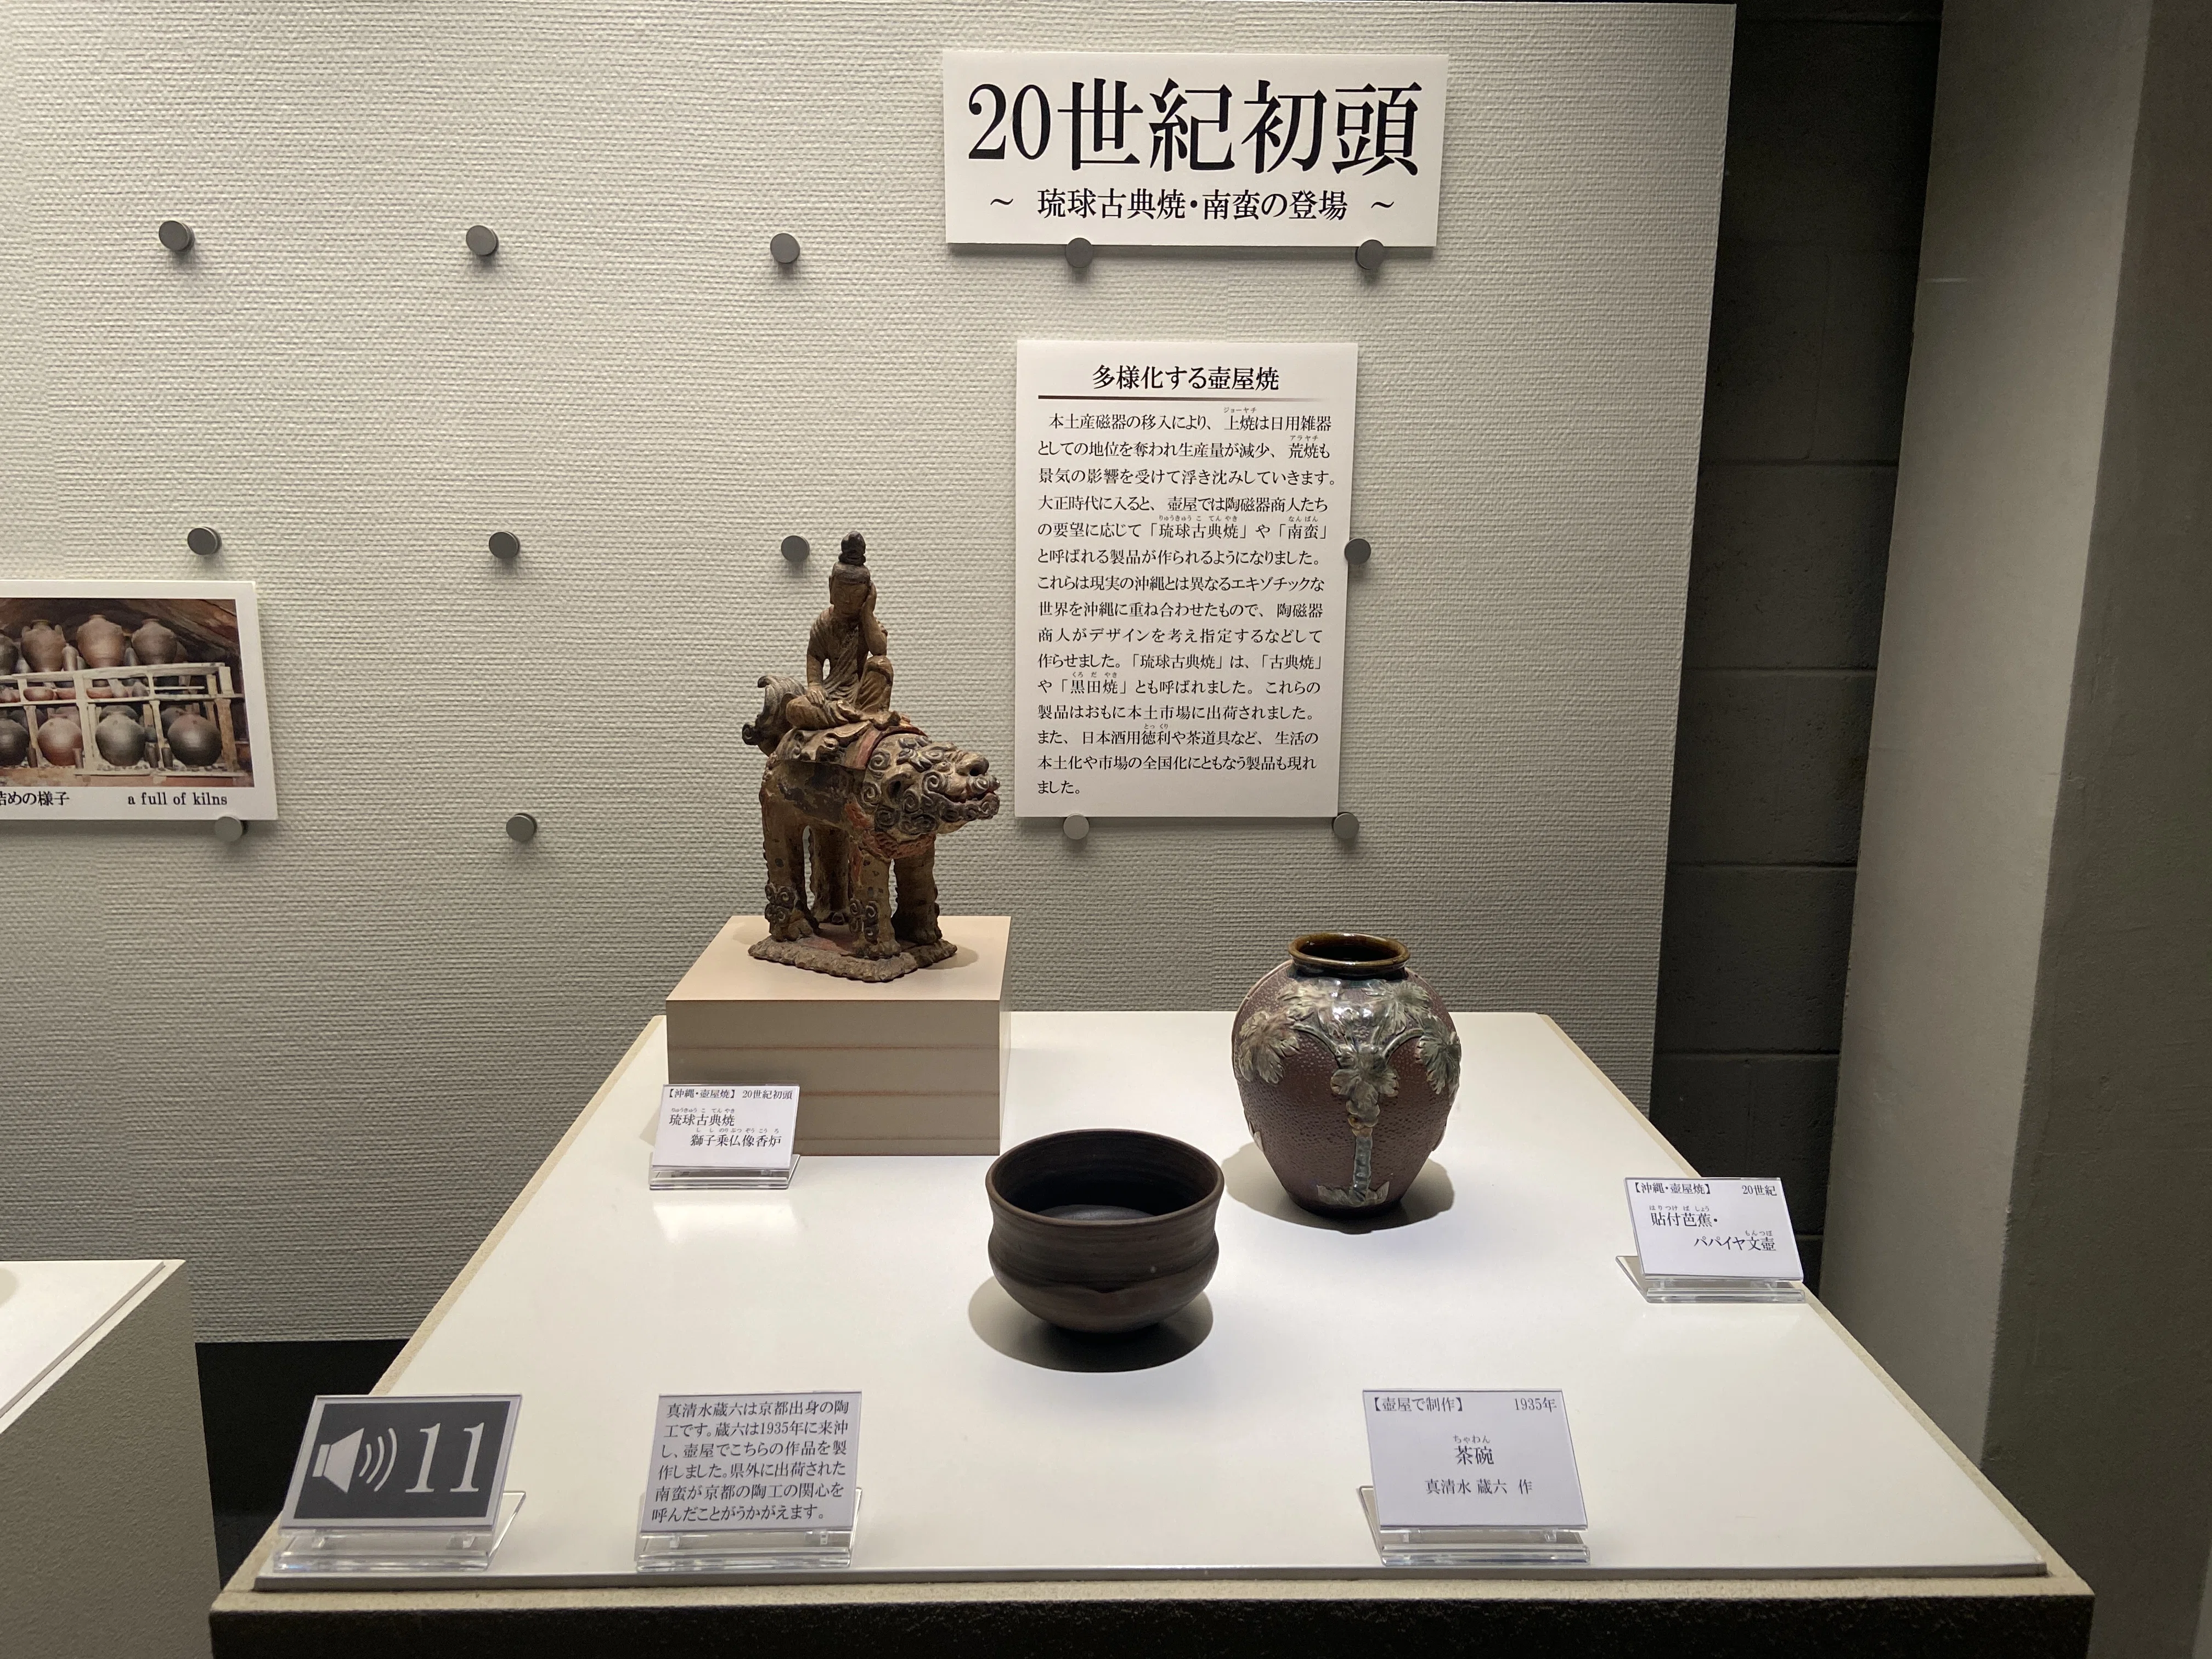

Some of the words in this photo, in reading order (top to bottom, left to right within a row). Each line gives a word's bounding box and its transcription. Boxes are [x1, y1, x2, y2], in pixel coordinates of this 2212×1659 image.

[967, 77, 1423, 177] 20世紀初頭
[1092, 364, 1280, 391] 多様化する壺屋焼
[1037, 780, 1083, 795] ました。
[127, 796, 136, 805] a
[141, 792, 167, 806] full
[173, 792, 187, 805] of
[193, 793, 228, 806] kilns
[742, 1090, 793, 1100] 20世紀初頭
[669, 1114, 735, 1126] 琉球古典焼
[690, 1134, 782, 1148] 獅子乗仏像香炉
[1741, 1184, 1778, 1197] 20世紀
[1694, 1235, 1777, 1251] パパイヤ文壺
[666, 1399, 849, 1419] 真清水蔵六は京都出身の陶
[1514, 1396, 1558, 1413] 1935年
[404, 1422, 485, 1493] 11
[1454, 1445, 1495, 1465] 茶碗
[658, 1460, 847, 1480] 作しました。県外に出荷された
[654, 1482, 844, 1502] 南蛮が京都の陶工の関心を
[651, 1503, 824, 1523] 呼んだことがうかがえます。
